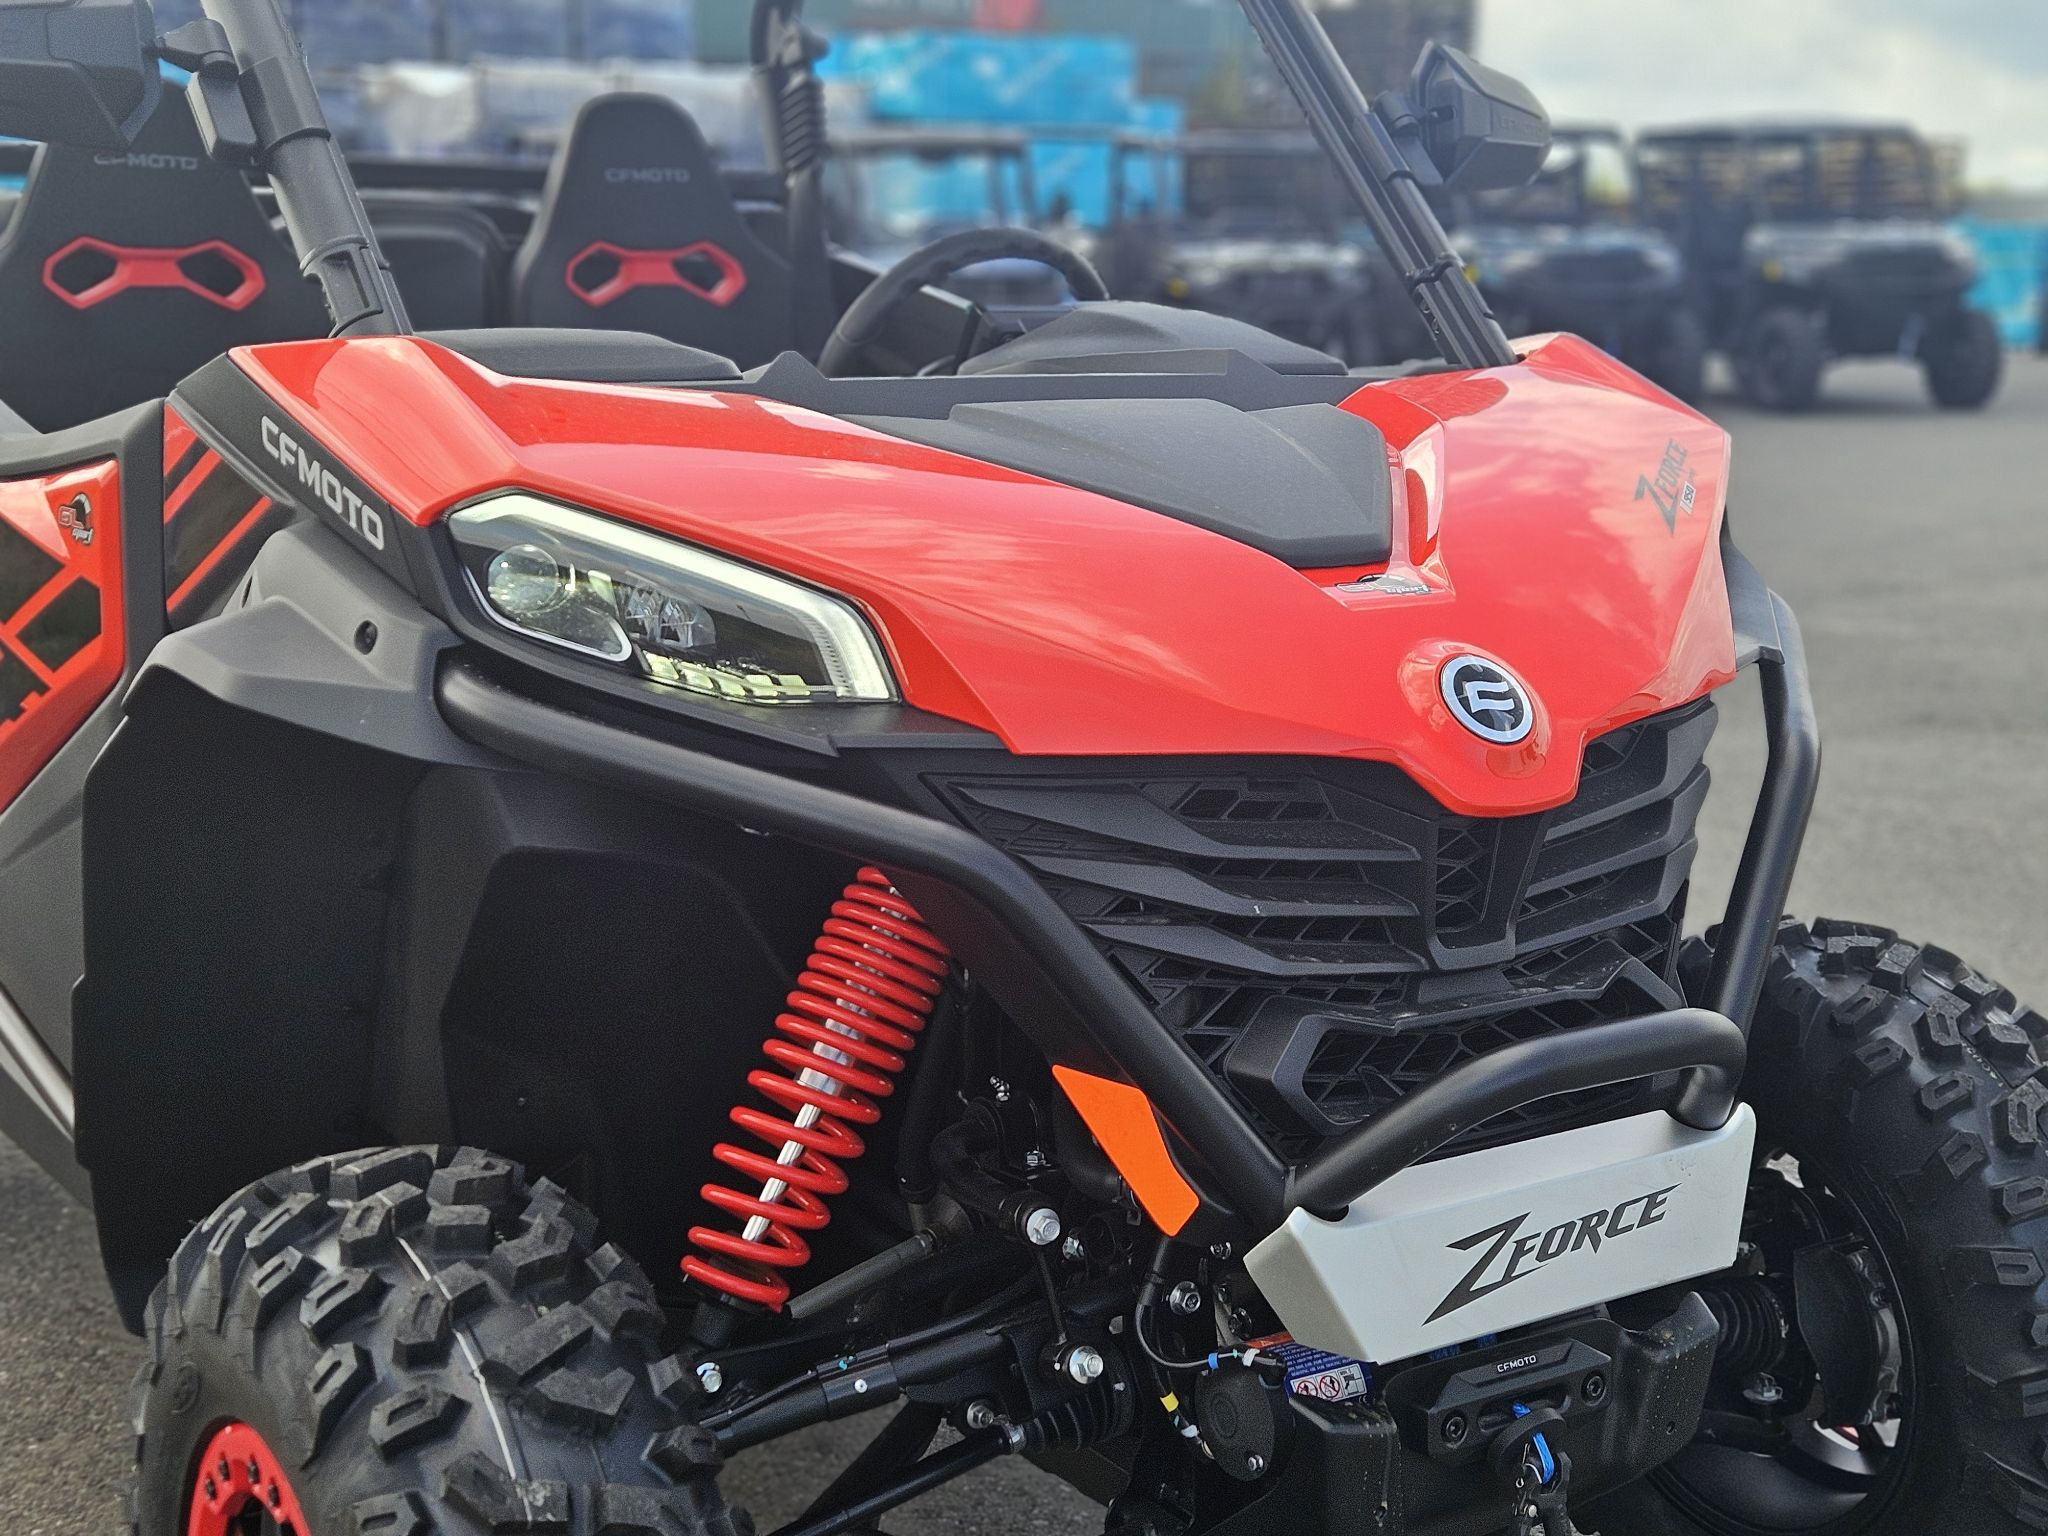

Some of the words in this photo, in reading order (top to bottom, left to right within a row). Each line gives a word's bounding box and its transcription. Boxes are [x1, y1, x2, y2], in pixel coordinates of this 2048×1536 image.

[261, 415, 385, 550] CFMOTO
[1421, 1182, 1683, 1327] ZFORCE
[1497, 1355, 1537, 1373] CFMOTO
